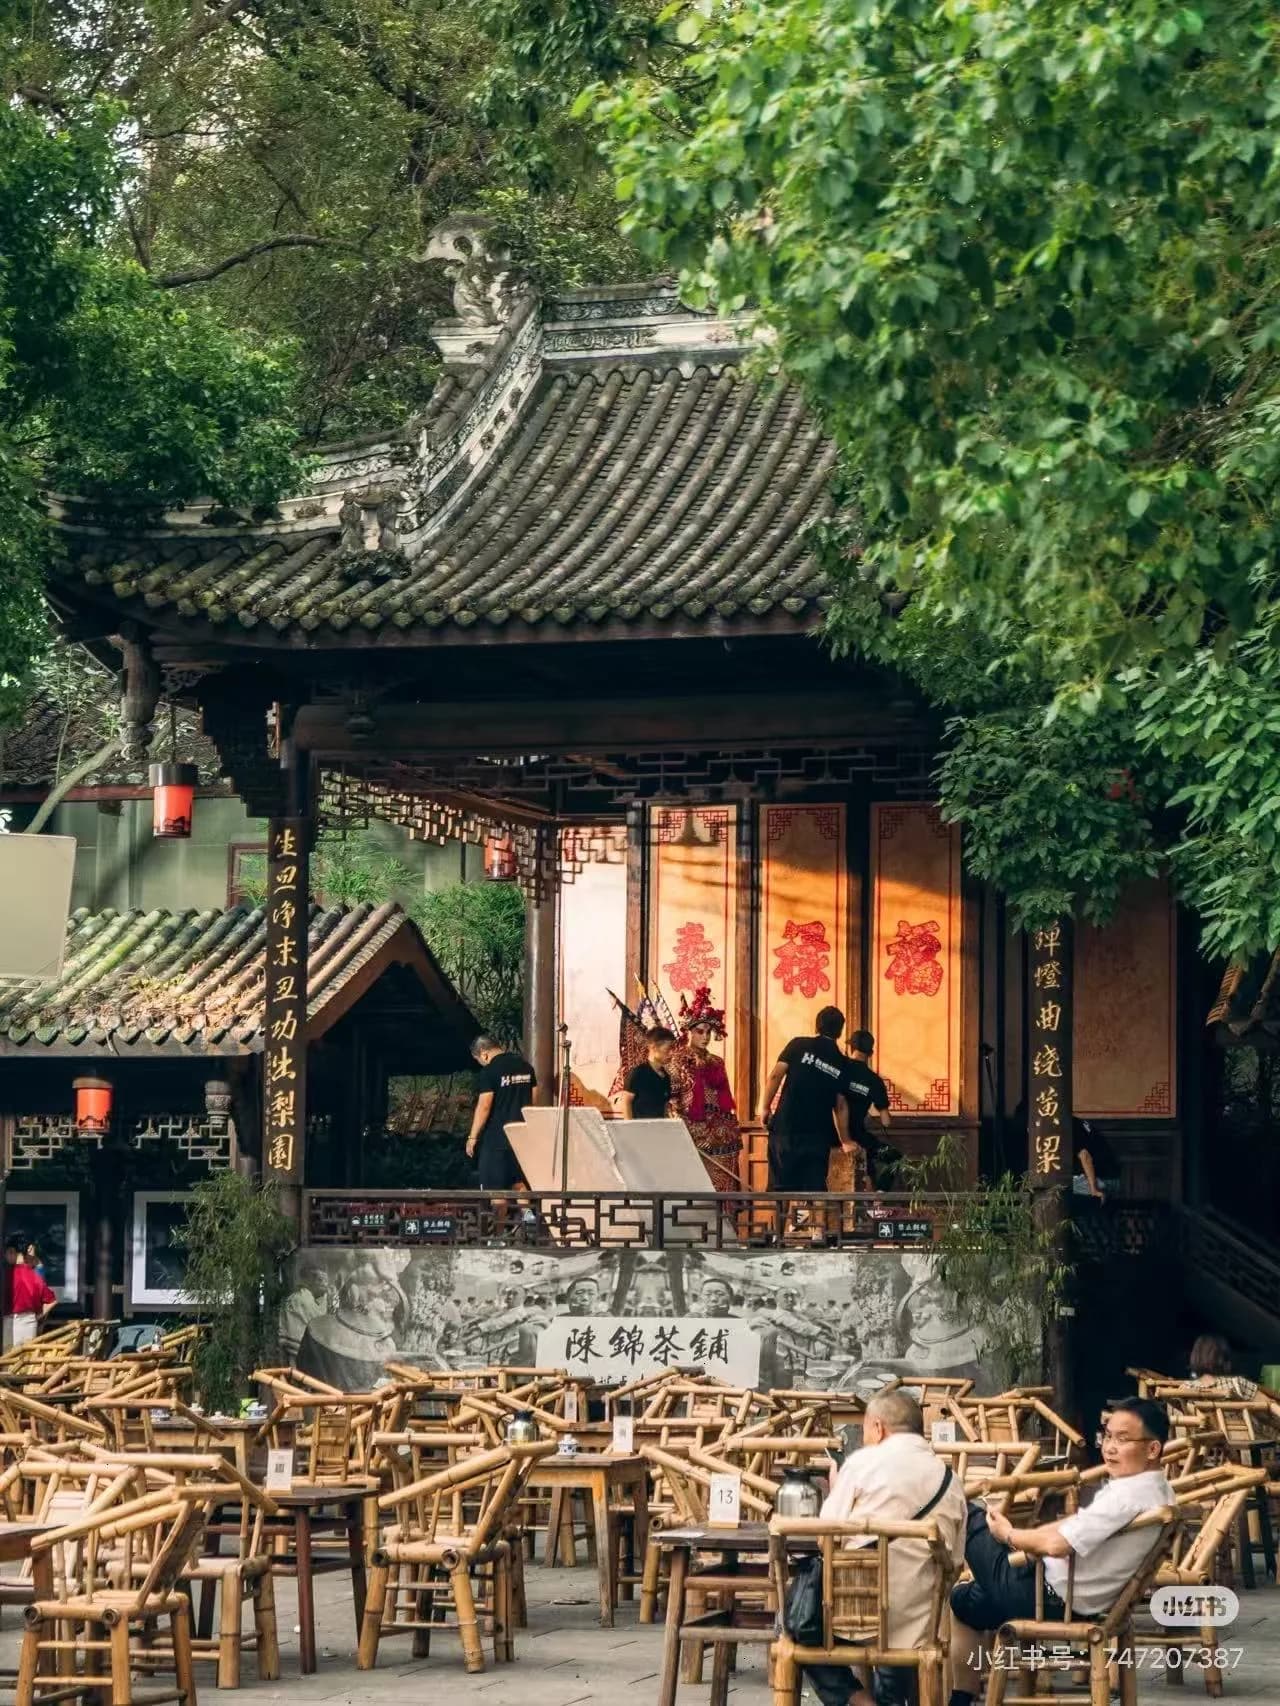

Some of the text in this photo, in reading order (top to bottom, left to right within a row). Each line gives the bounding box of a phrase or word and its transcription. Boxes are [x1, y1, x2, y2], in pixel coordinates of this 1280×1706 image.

[883, 919, 944, 998] 福
[565, 1323, 730, 1366] 陳錦茶鋪
[719, 1488, 734, 1505] 13
